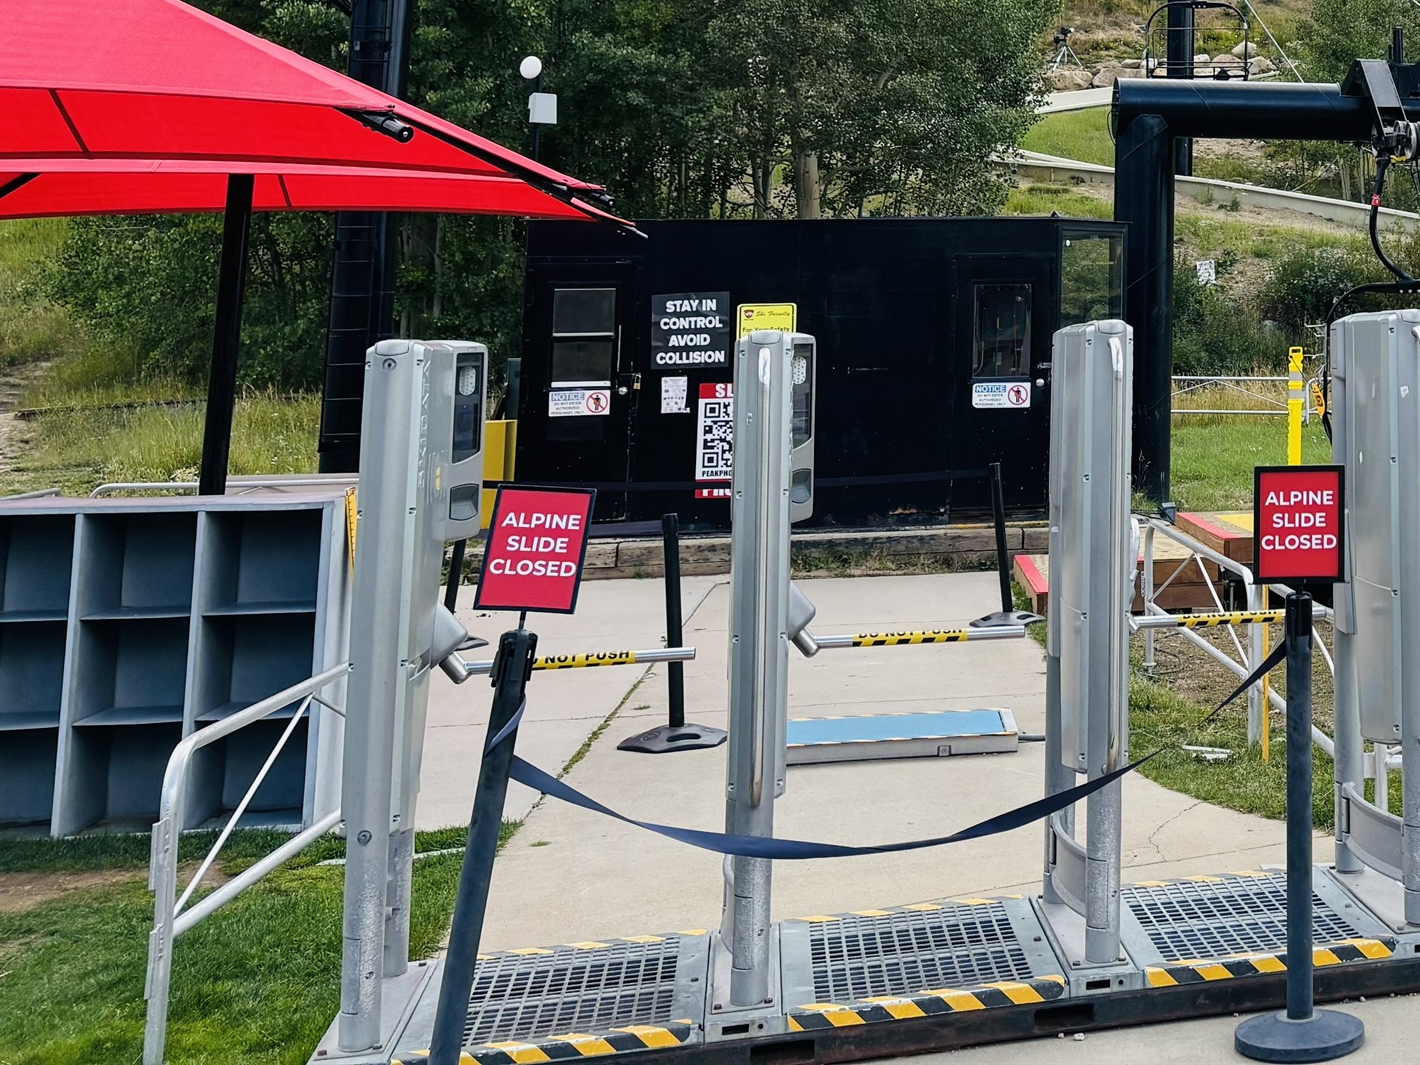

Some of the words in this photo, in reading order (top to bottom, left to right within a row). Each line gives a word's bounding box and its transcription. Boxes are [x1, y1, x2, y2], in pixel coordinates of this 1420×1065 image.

[665, 299, 700, 312] STAY
[701, 298, 716, 311] IN
[660, 315, 723, 329] CONTROL
[668, 333, 710, 346] AVOID
[655, 350, 724, 364] COLLISION
[975, 385, 1006, 393] NOTICE
[552, 393, 584, 401] NOTICE
[1264, 490, 1333, 505] ALPINE
[501, 512, 581, 530] ALPINE
[1272, 512, 1326, 527] SLIDE
[505, 535, 569, 553] SLIDE
[1261, 534, 1337, 550] CLOSED
[489, 558, 576, 576] CLOSED
[545, 654, 577, 664] NOT
[585, 650, 630, 661] PUSH
